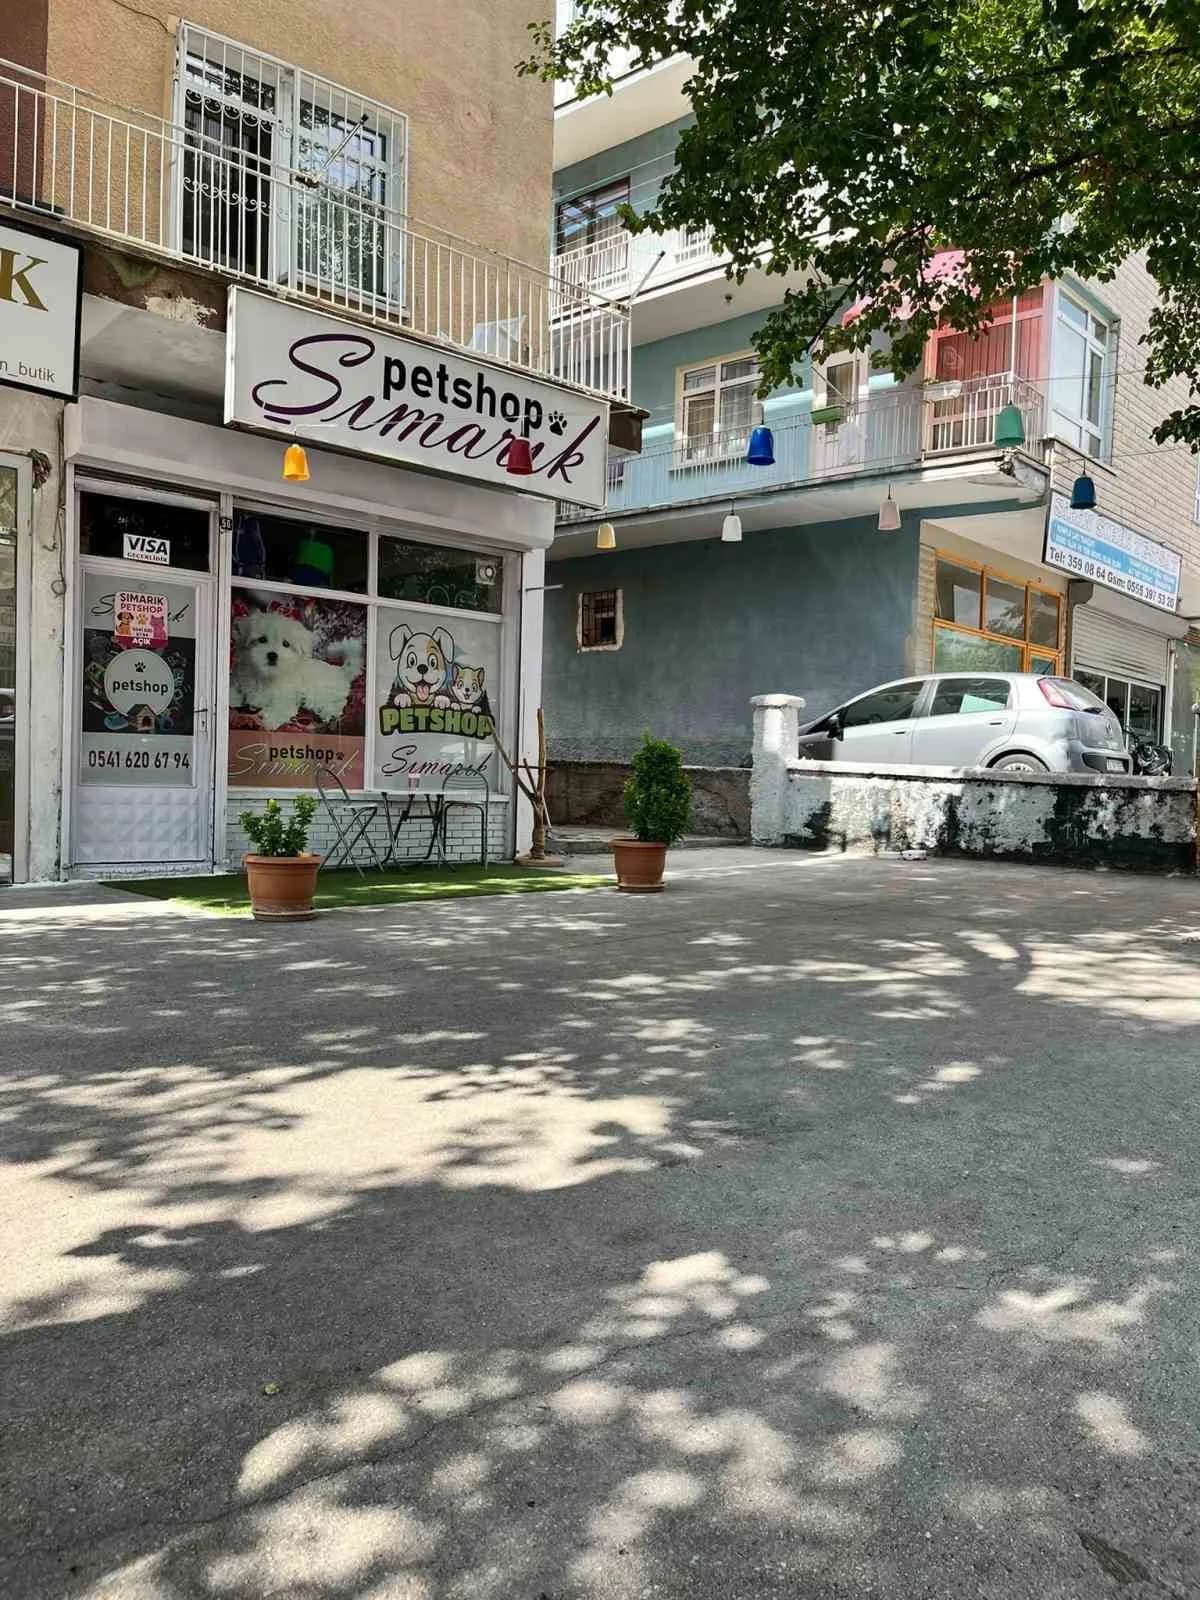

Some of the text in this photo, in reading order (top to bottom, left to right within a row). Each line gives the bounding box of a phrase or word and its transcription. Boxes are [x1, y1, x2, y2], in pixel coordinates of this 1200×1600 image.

[384, 355, 542, 438] petshop
[127, 536, 168, 555] VISA
[1049, 546, 1066, 563] Tel:
[1067, 554, 1083, 570] 359
[1084, 563, 1095, 577] 08
[1096, 567, 1106, 580] 64
[120, 602, 163, 615] PETSHOP
[112, 679, 169, 696] petshop
[380, 704, 494, 739] PETSHOP
[88, 750, 190, 769] 0541 620 67 94
[269, 744, 334, 763] petshop
